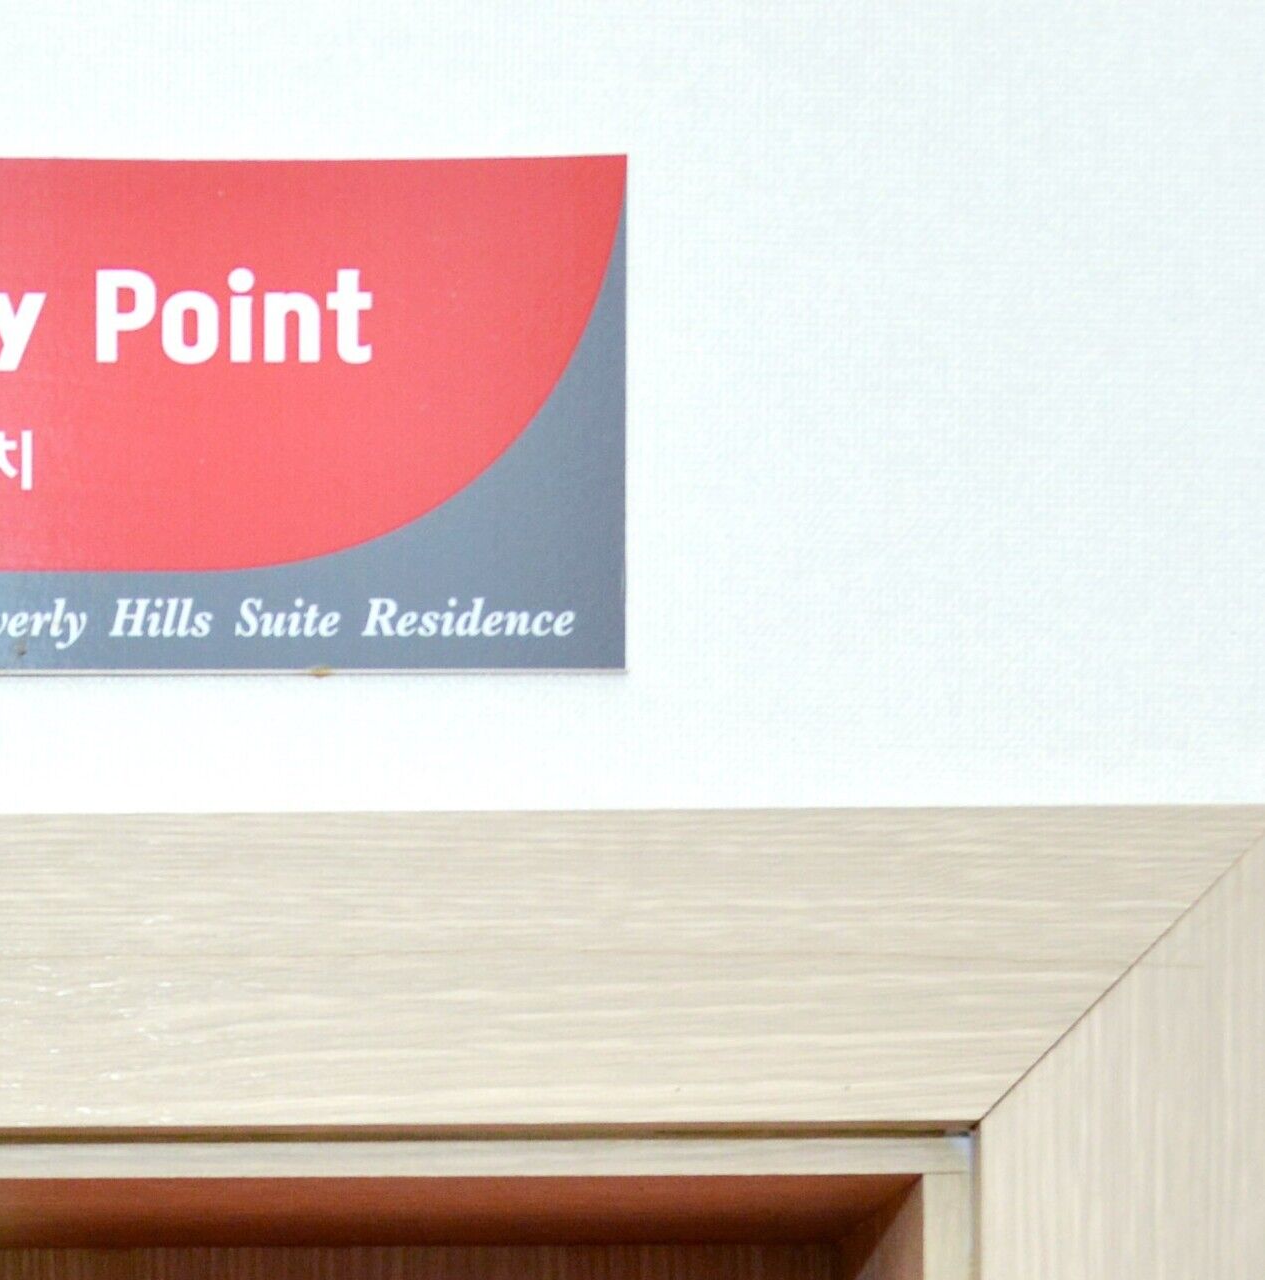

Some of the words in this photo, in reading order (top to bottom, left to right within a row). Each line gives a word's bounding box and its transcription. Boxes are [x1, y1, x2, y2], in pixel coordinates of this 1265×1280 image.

[95, 266, 373, 365] Point
[110, 597, 212, 640] Hills
[234, 597, 340, 640] Suite
[361, 597, 576, 640] Residence
